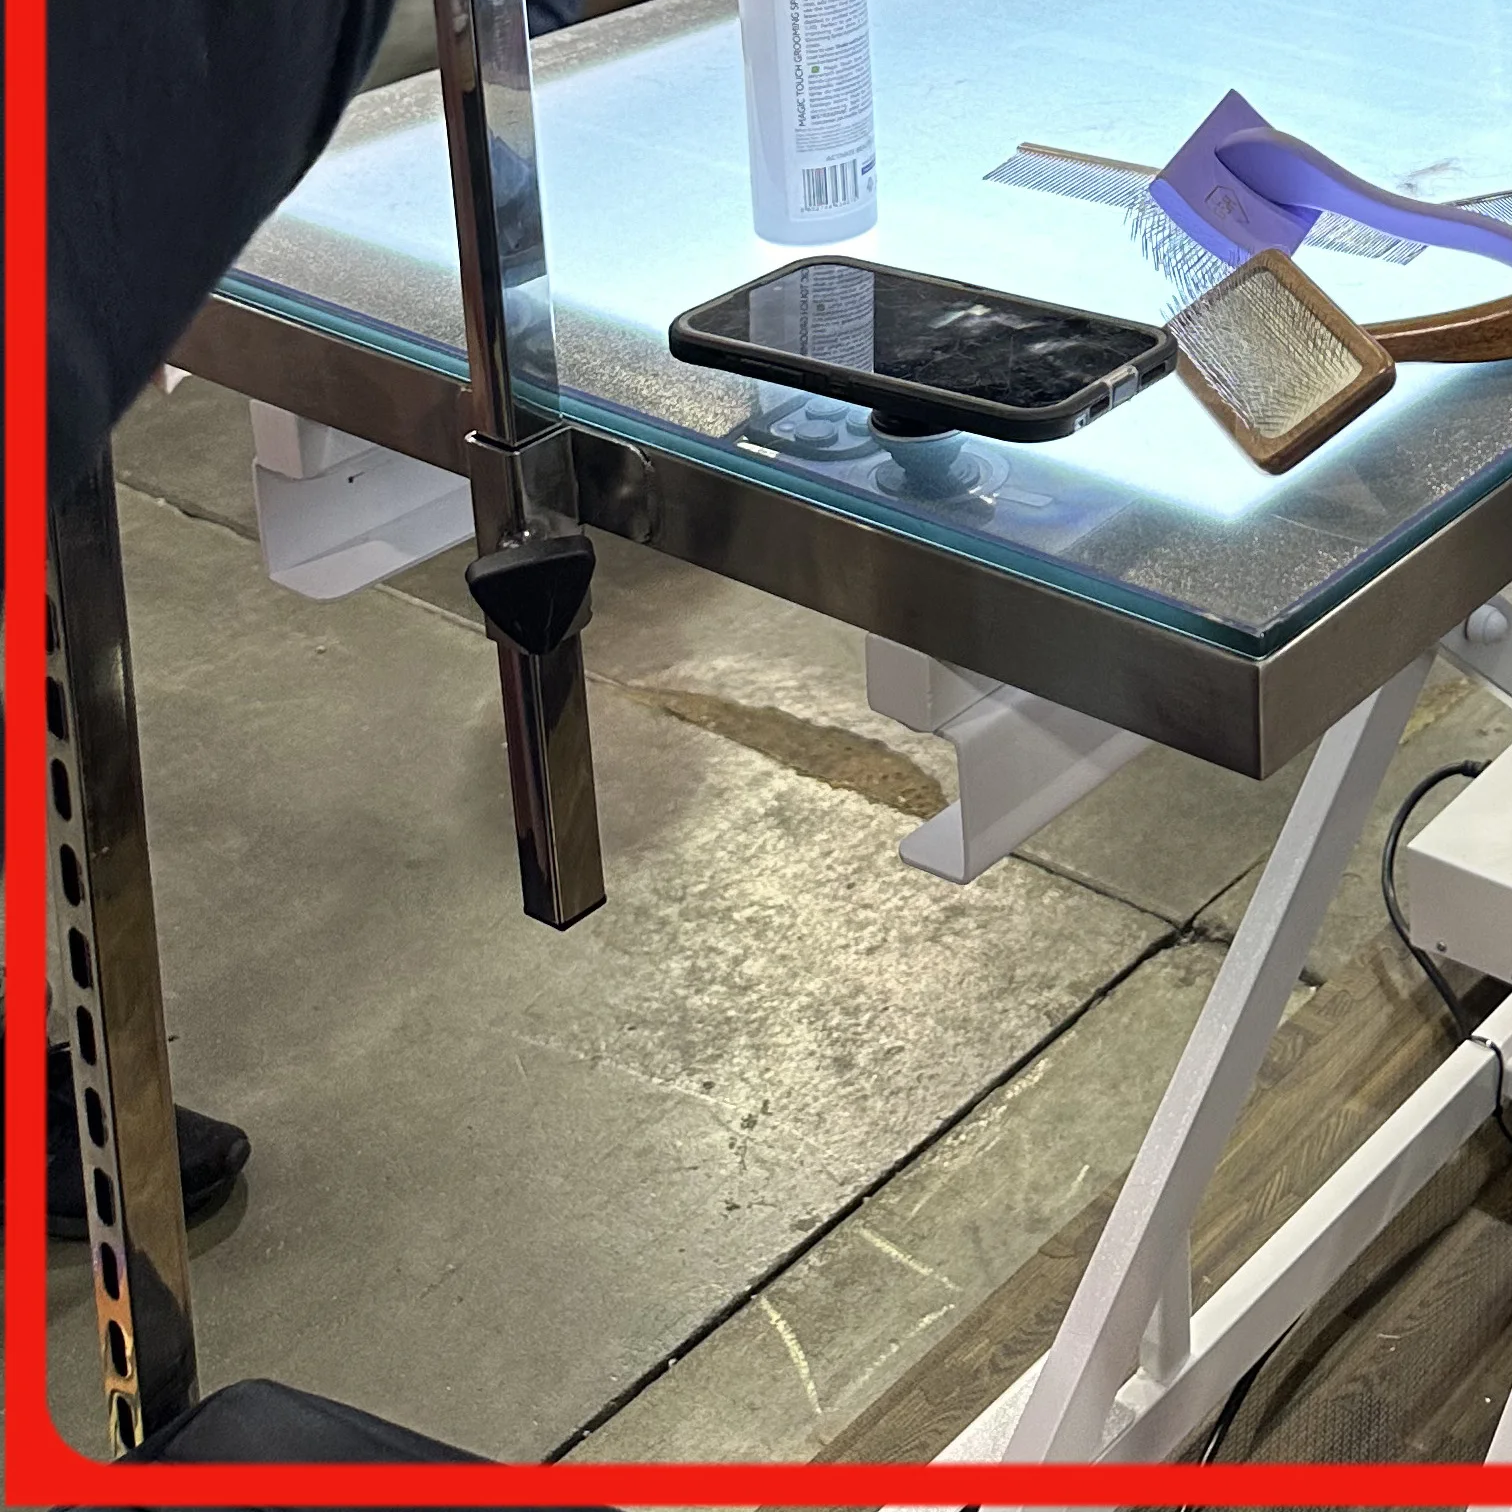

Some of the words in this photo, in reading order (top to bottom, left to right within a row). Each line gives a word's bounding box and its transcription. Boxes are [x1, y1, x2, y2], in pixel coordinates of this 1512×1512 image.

[790, 12, 802, 63] GROOMING
[793, 64, 805, 97] TOUCH
[796, 99, 806, 126] MAGIC
